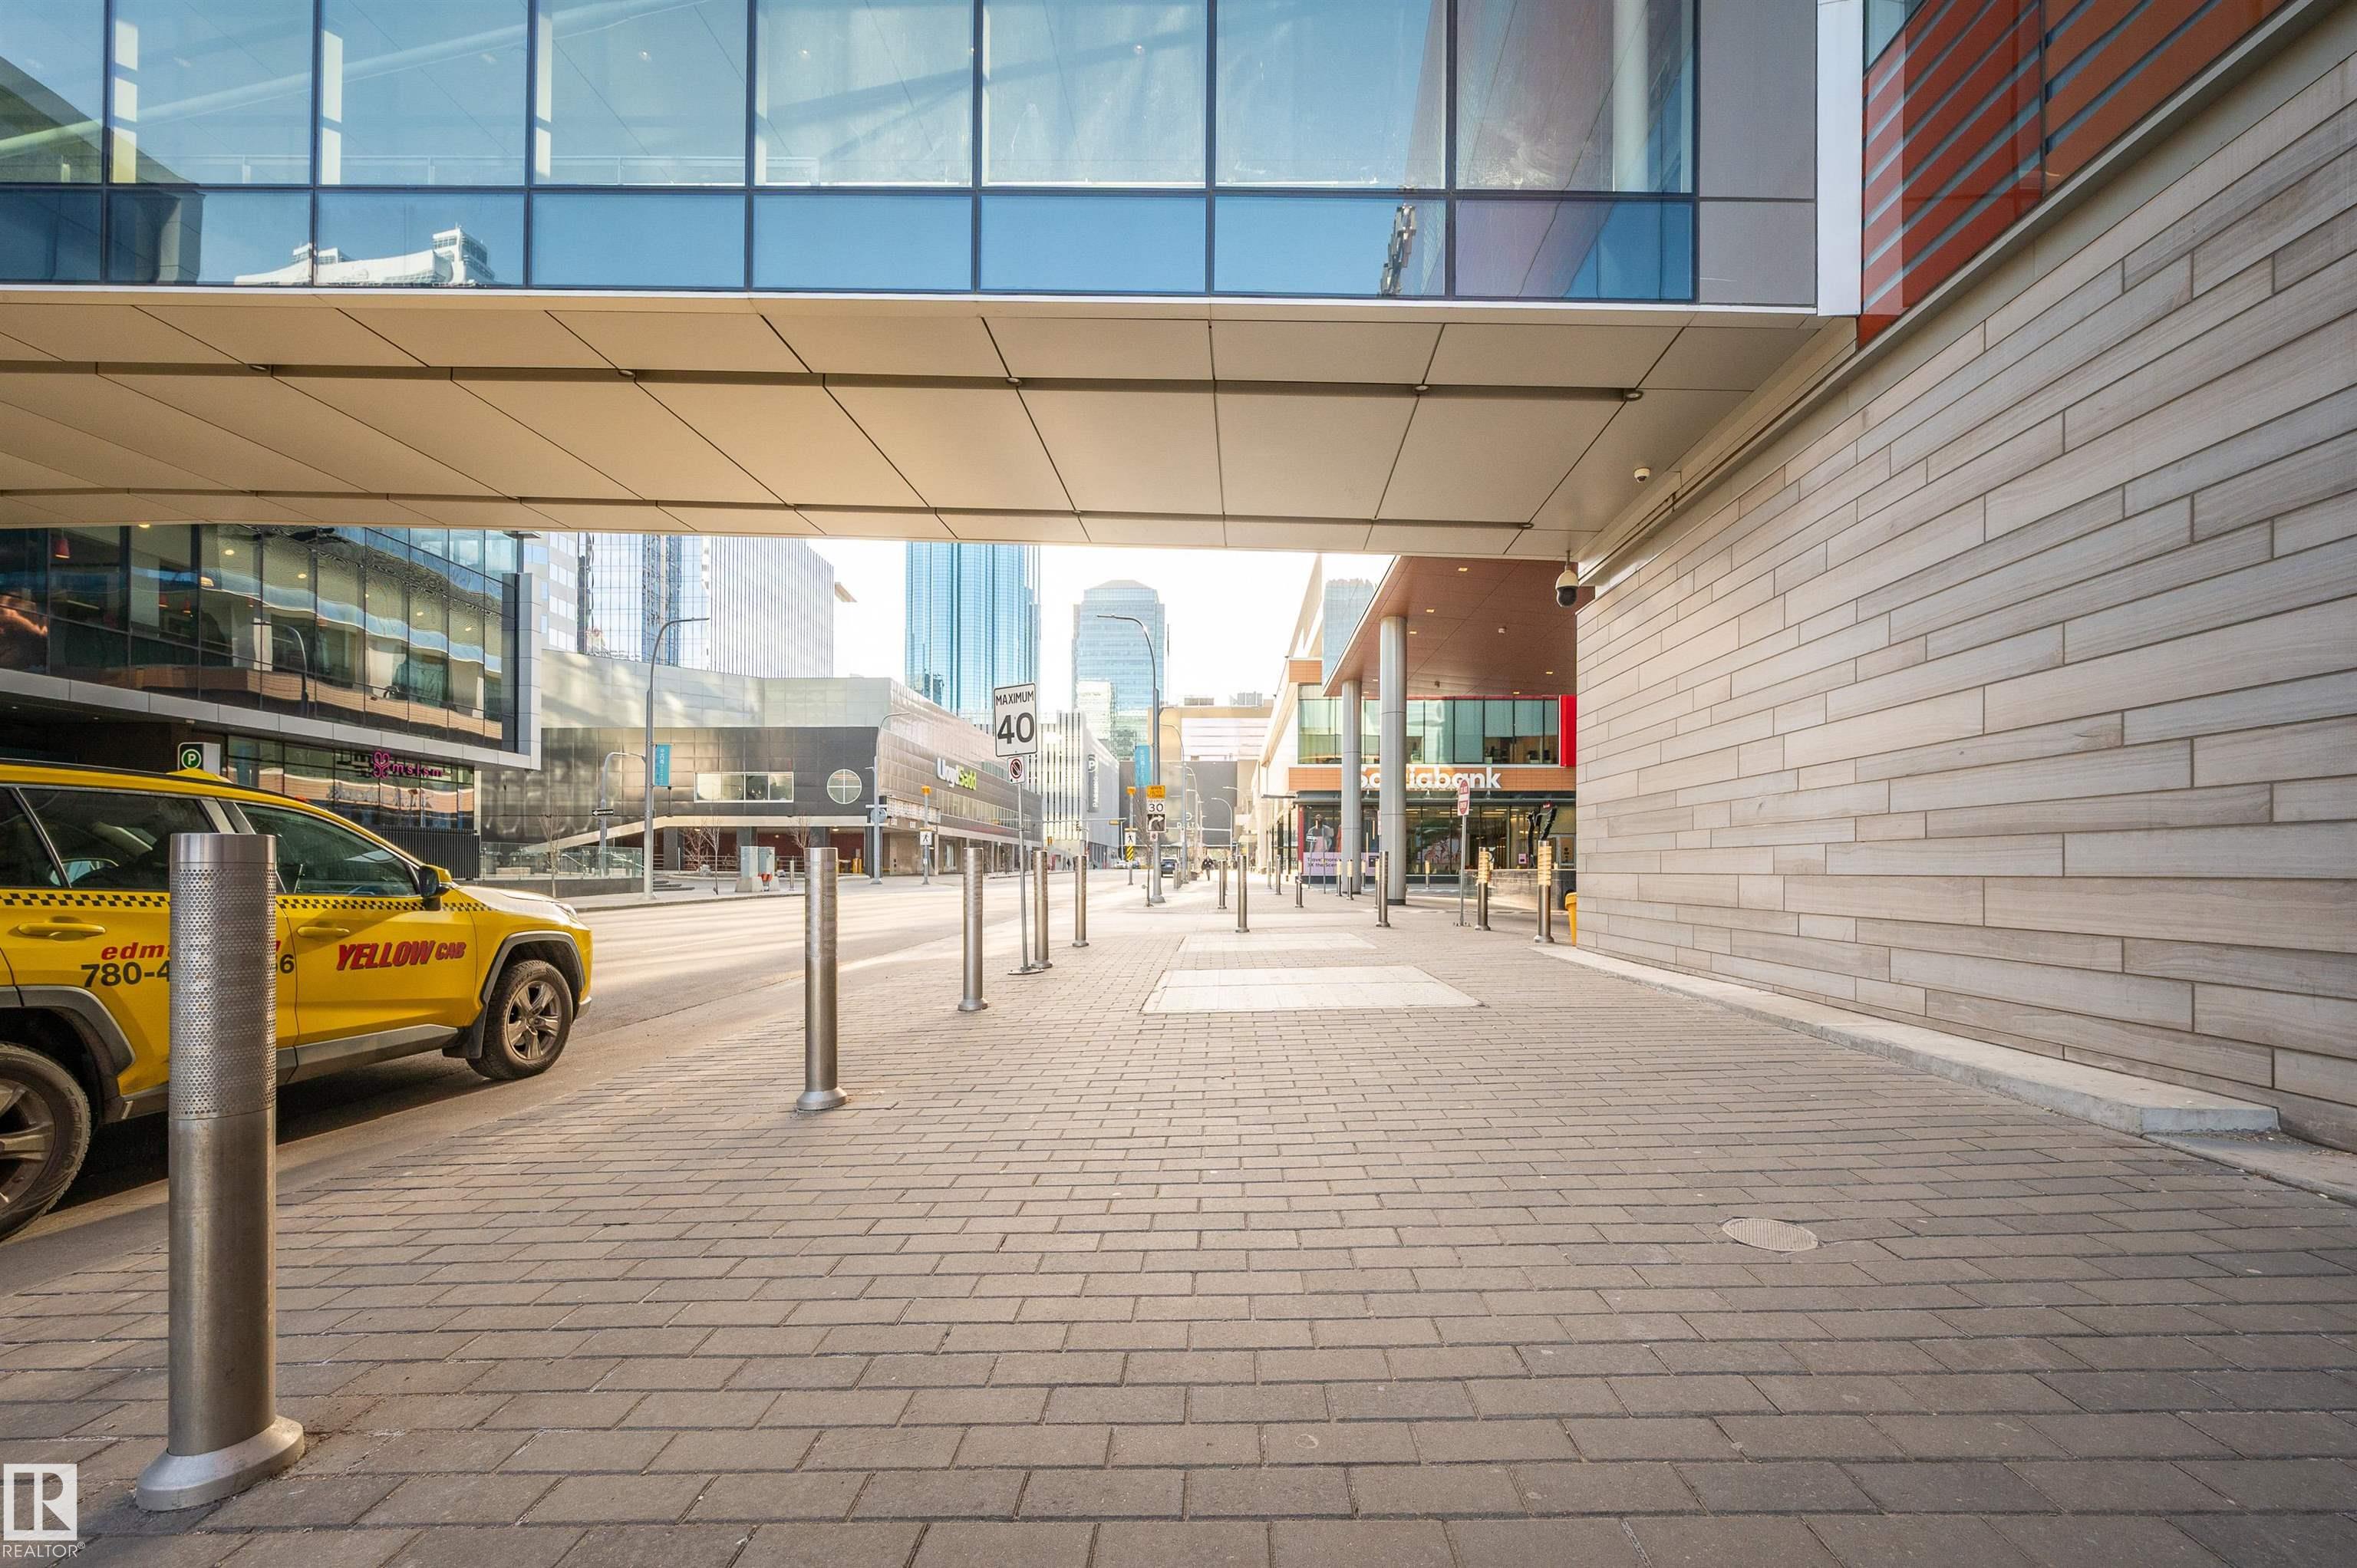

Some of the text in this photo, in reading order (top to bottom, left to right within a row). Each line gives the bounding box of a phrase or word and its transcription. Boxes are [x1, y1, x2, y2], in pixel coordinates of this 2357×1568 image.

[996, 691, 1034, 706] MAXIMUM
[997, 712, 1035, 744] 40
[1149, 803, 1164, 812] 30
[336, 940, 466, 971] YELLOW CAB
